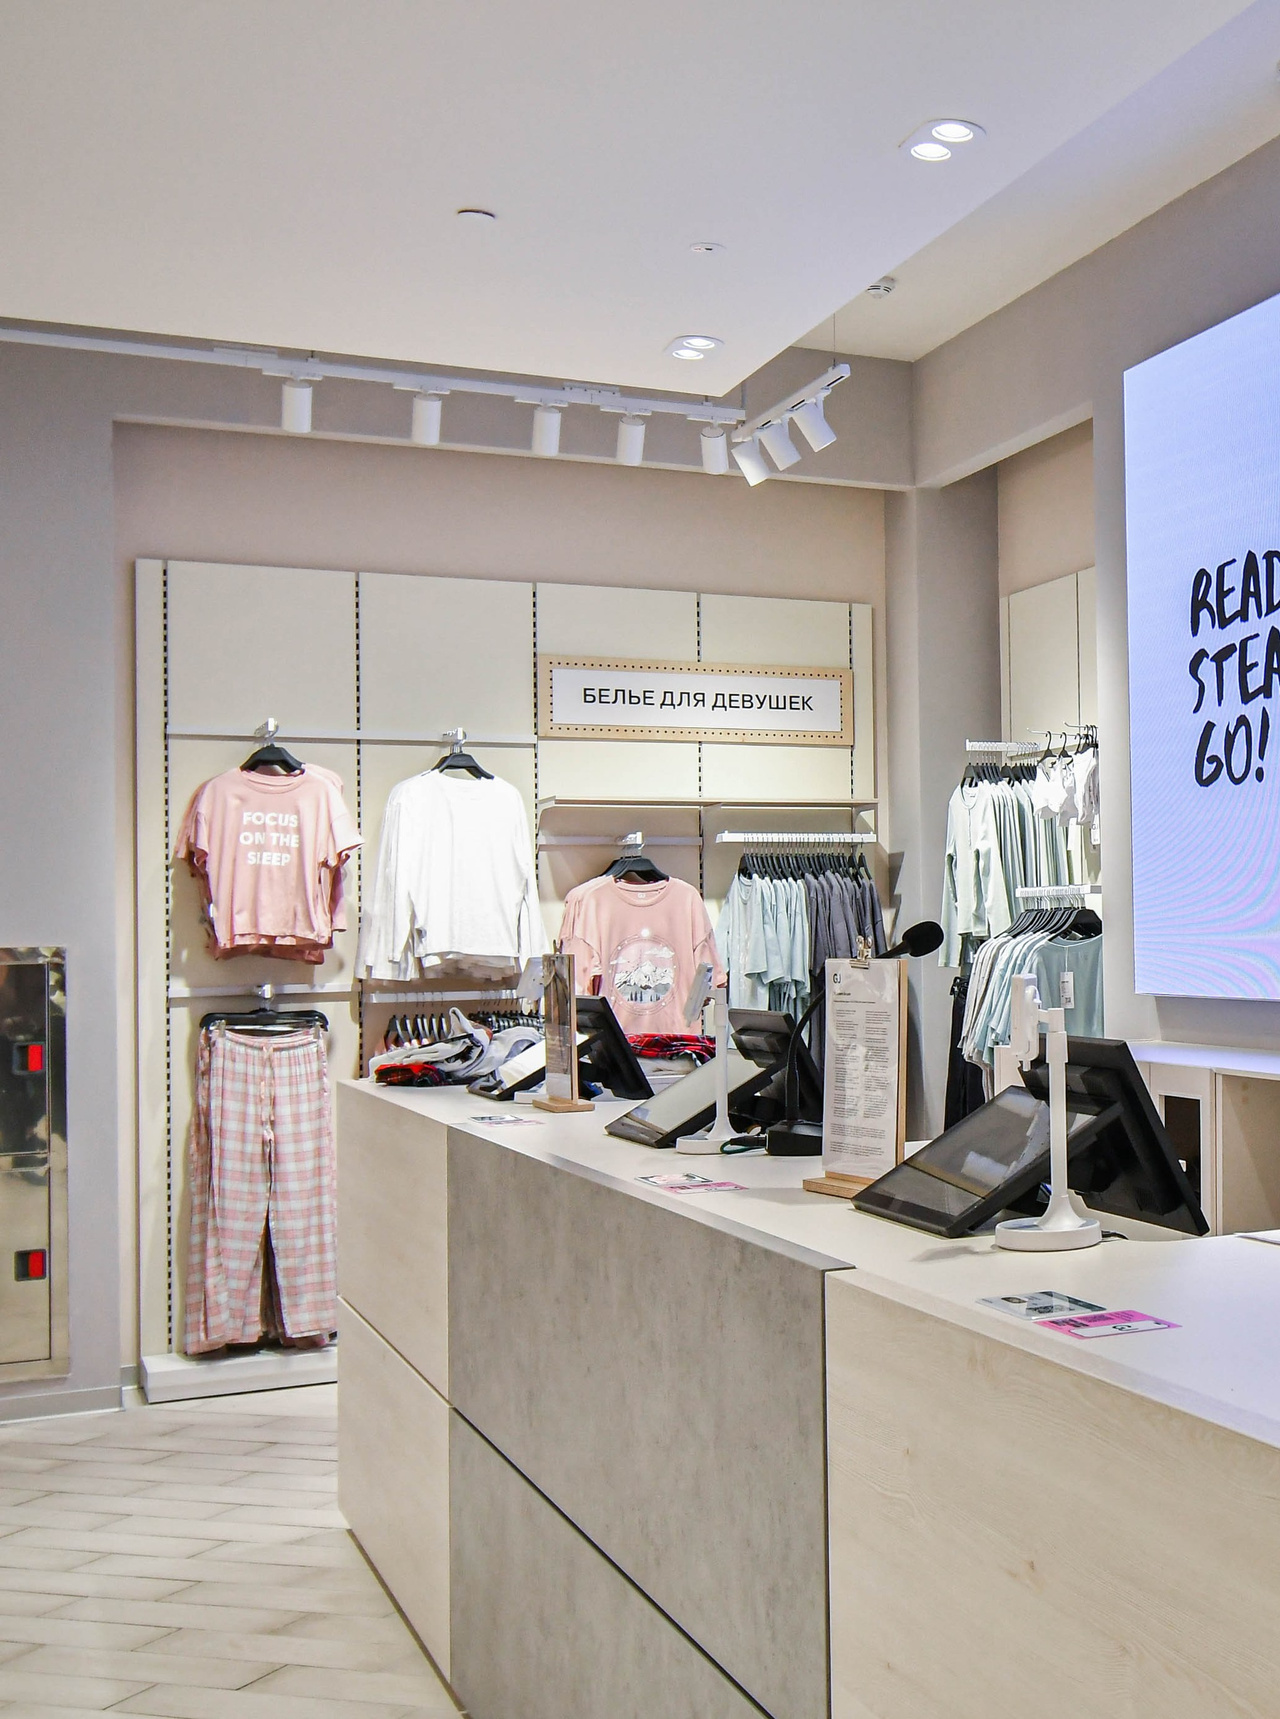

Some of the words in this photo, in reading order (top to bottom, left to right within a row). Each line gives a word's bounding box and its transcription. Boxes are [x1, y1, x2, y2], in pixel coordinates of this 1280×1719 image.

[582, 687, 655, 706] БЕЛЬЕ
[659, 690, 707, 710] ДЛЯ
[711, 692, 814, 712] ДЕВУШЕК
[1195, 706, 1270, 788] GO!
[242, 811, 298, 828] FOCUS
[239, 831, 266, 846] ON
[269, 832, 300, 848] THE
[832, 973, 842, 984] GJ
